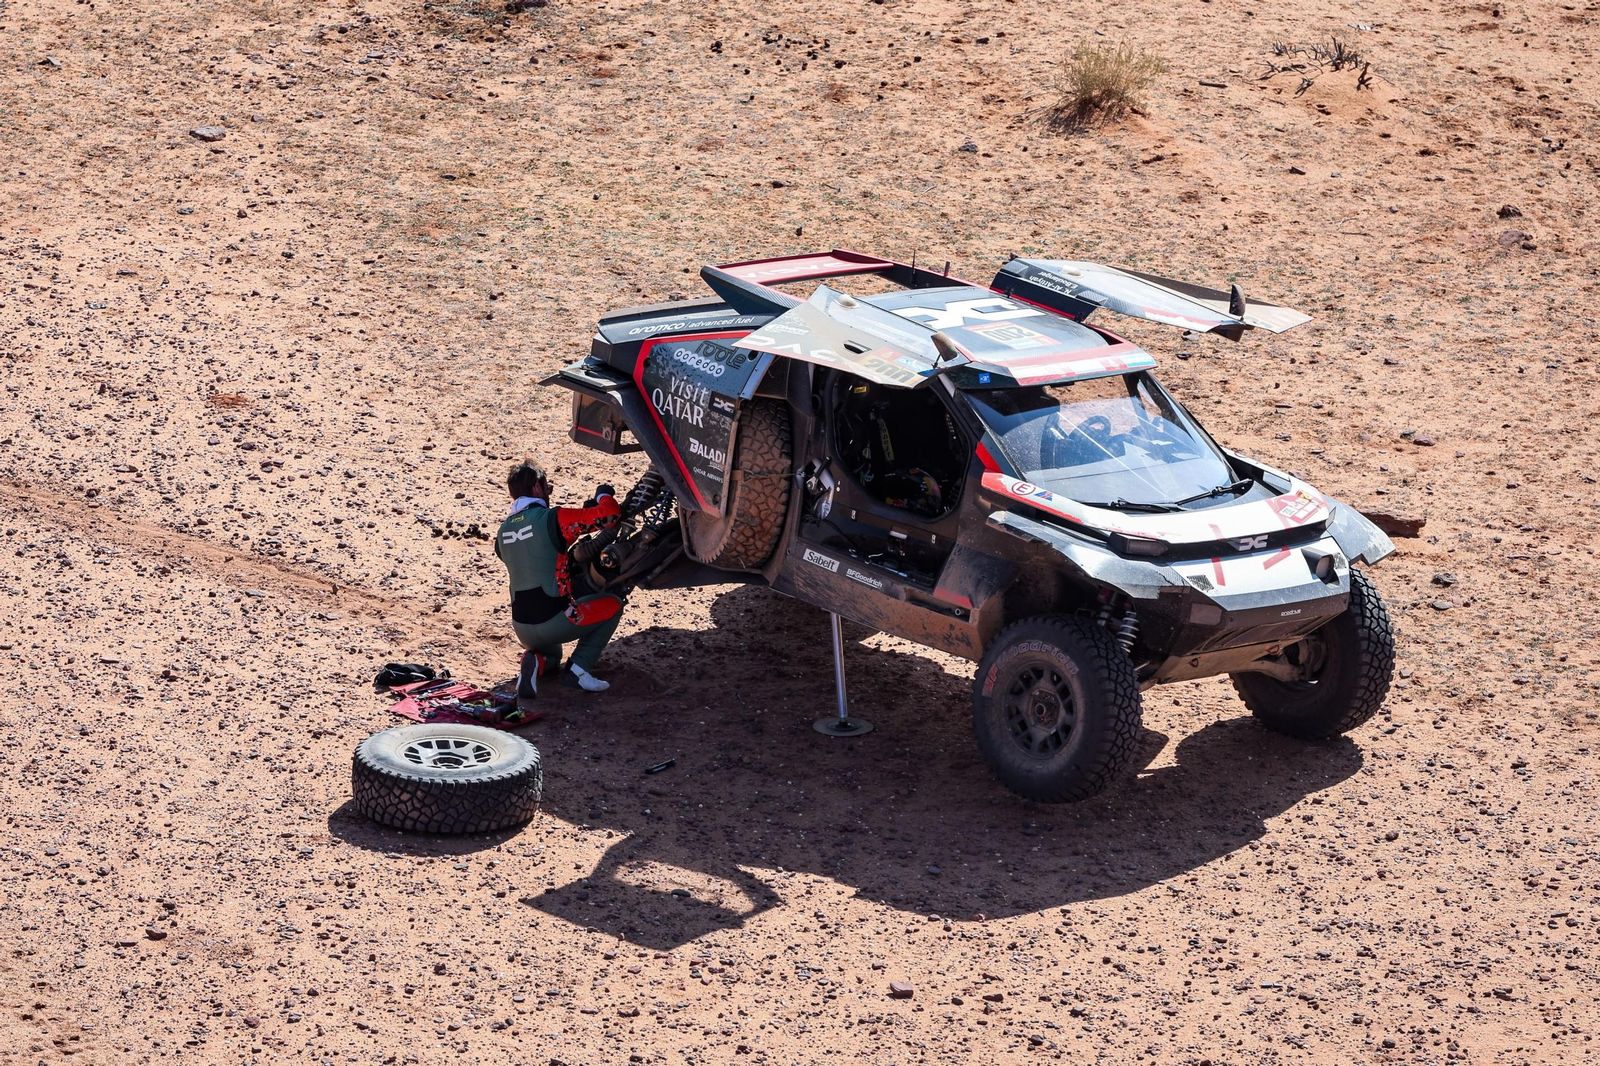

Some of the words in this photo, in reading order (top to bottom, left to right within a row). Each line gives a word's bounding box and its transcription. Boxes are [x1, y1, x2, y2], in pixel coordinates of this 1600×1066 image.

[628, 322, 685, 335] aramco
[688, 317, 734, 329] advanced
[735, 316, 755, 325] fuel
[674, 348, 725, 377] ooredoo
[671, 376, 708, 406] visit
[652, 388, 704, 428] QATAR
[689, 437, 727, 465] BALADI
[807, 551, 836, 570] Sabelt
[846, 568, 883, 588] BFGoodrich
